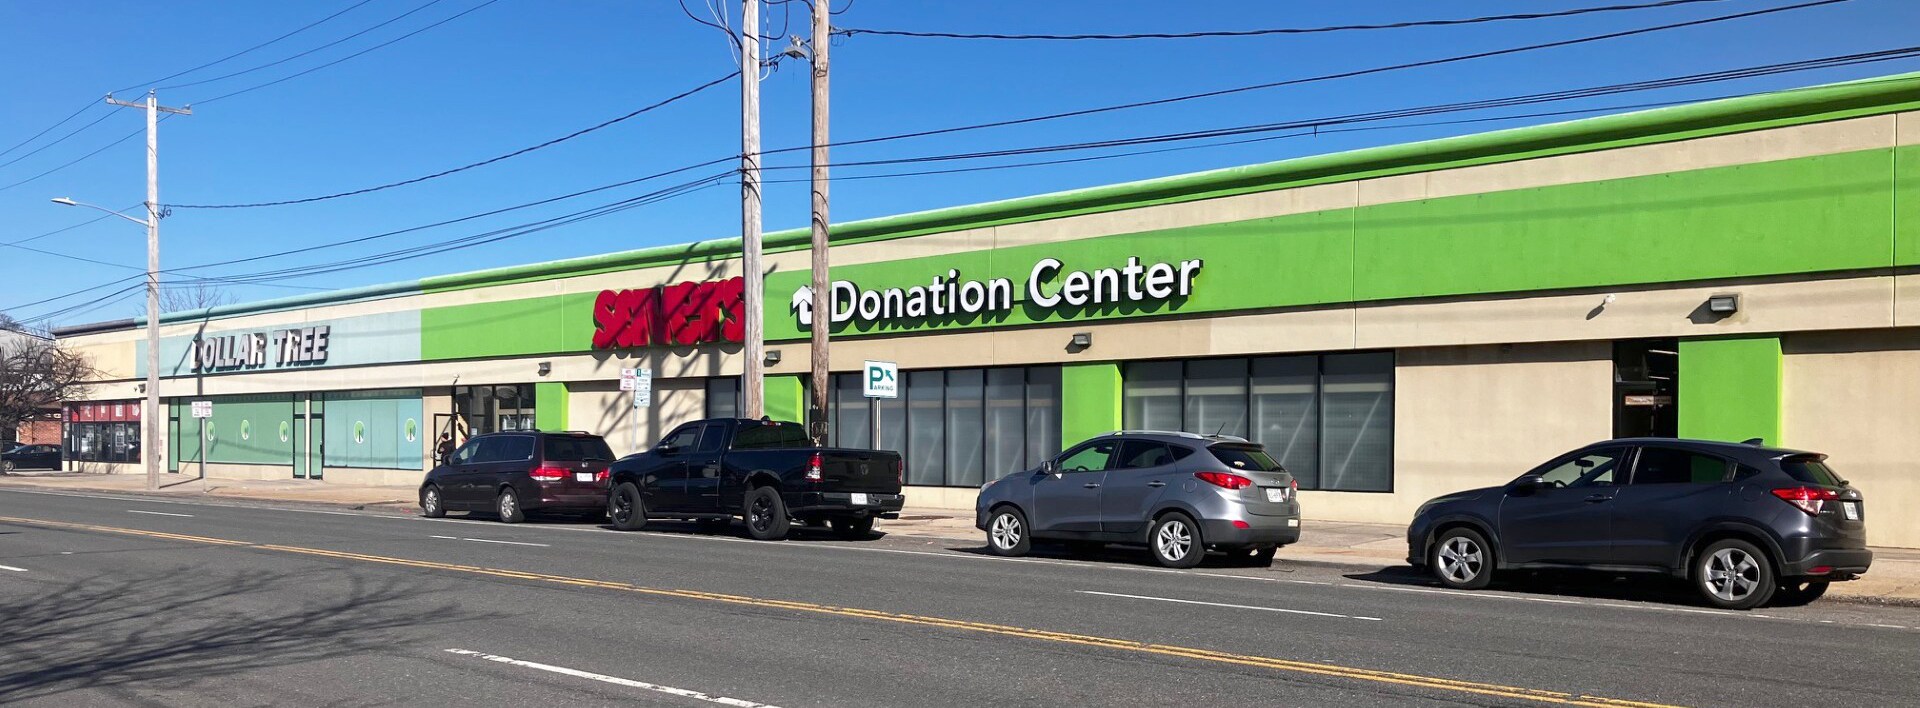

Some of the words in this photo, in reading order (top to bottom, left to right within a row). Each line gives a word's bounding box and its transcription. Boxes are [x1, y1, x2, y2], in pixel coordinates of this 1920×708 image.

[831, 268, 1012, 322] Donation
[1029, 256, 1200, 307] Center
[190, 332, 267, 370] DOLLAR
[273, 326, 330, 365] TREE
